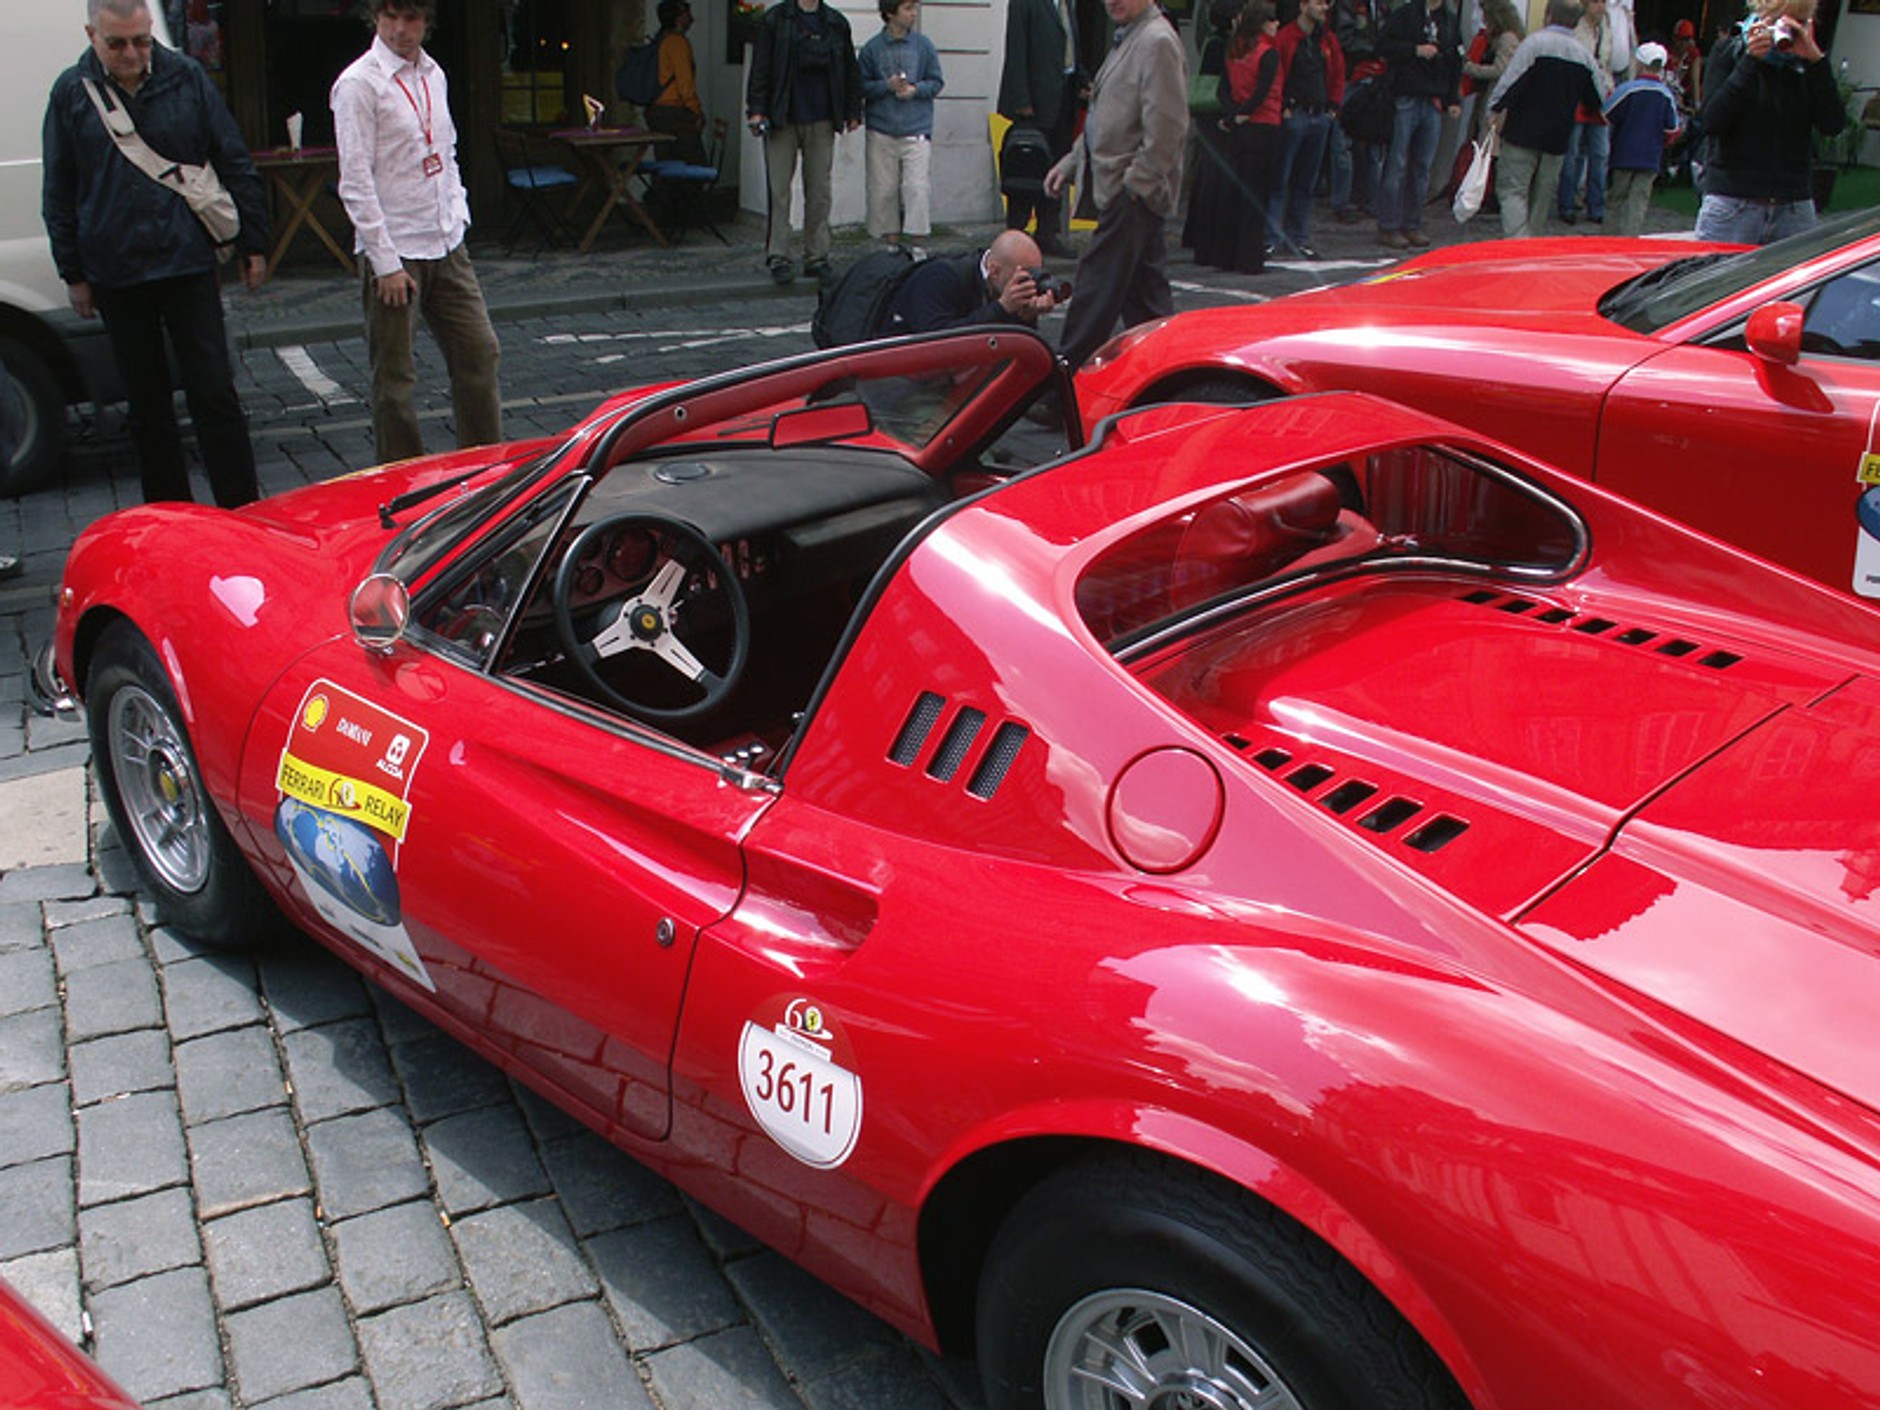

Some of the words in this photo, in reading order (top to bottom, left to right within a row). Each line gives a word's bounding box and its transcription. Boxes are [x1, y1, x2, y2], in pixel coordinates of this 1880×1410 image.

[282, 763, 325, 800] FERRARI
[364, 795, 403, 827] RELAY
[376, 759, 403, 779] ALCOA
[756, 1049, 834, 1135] 3611
